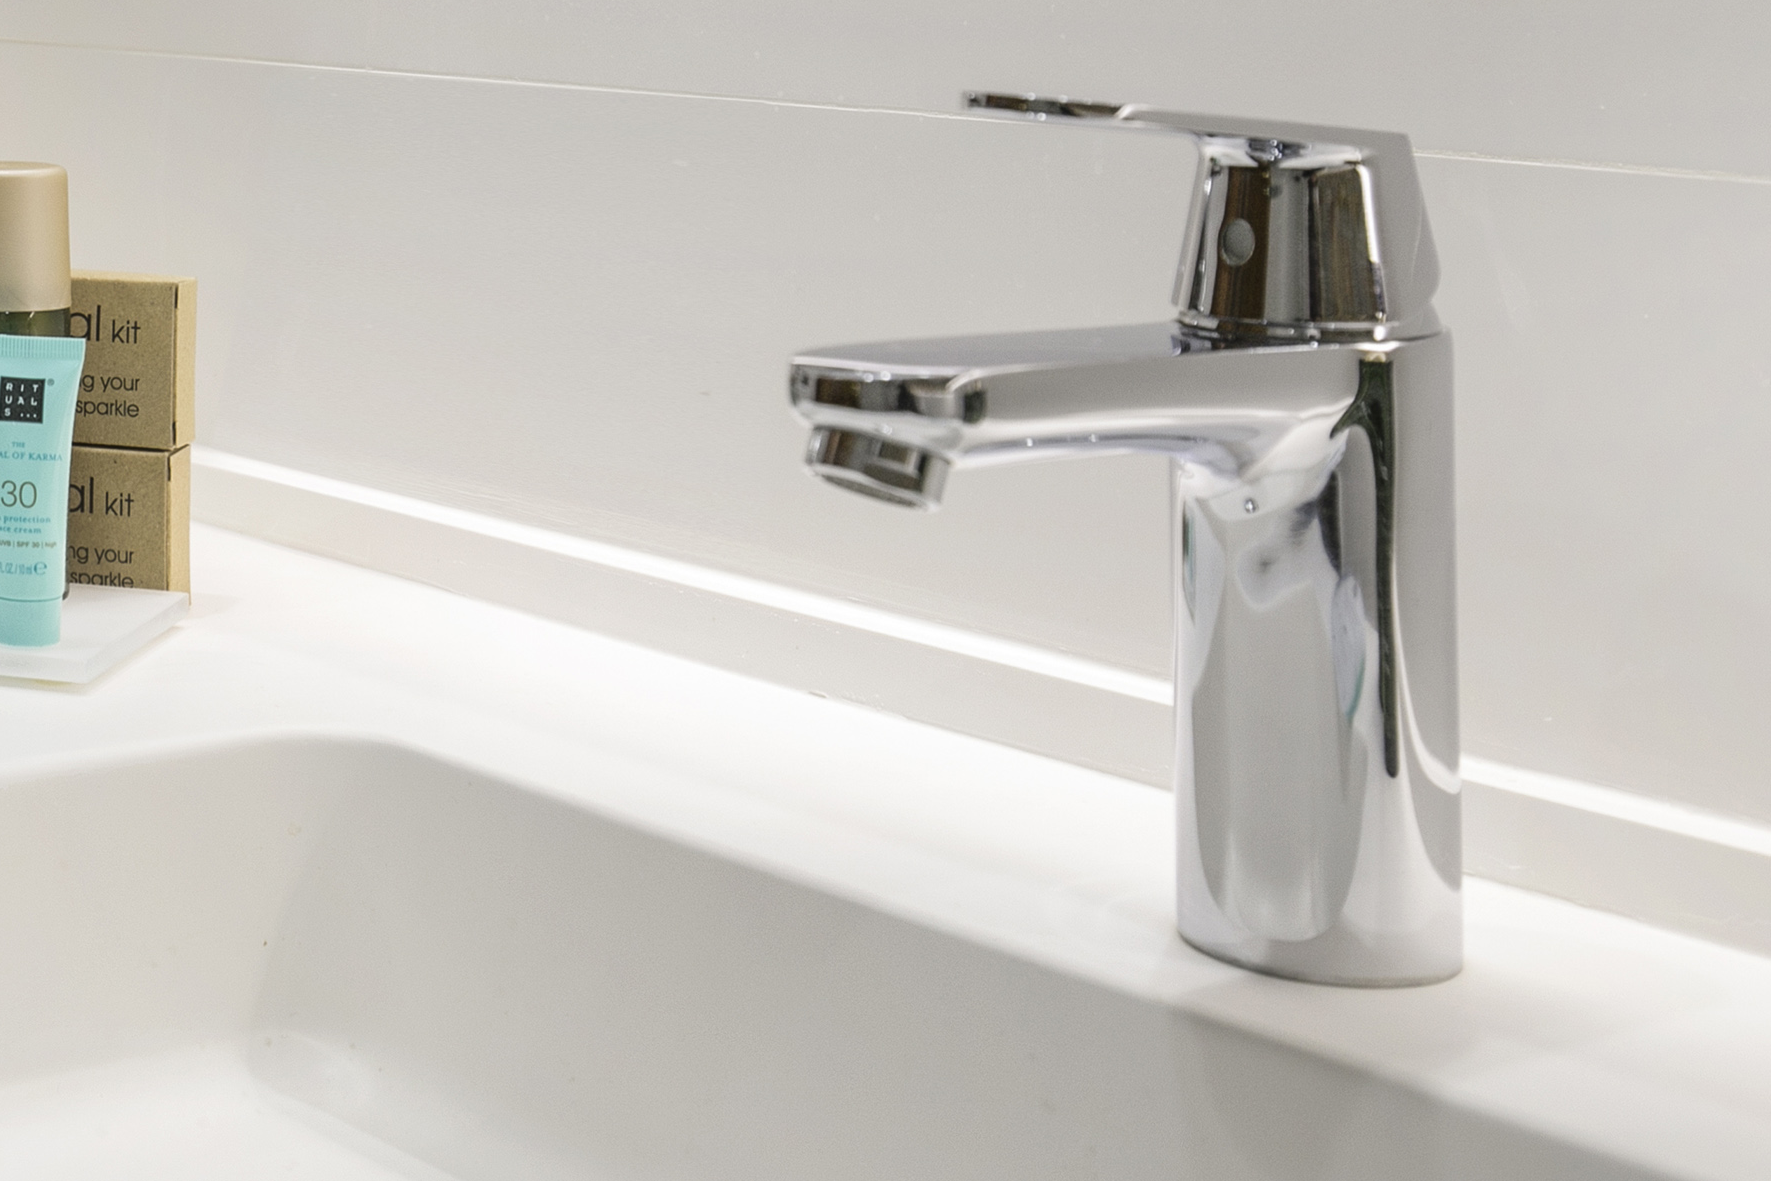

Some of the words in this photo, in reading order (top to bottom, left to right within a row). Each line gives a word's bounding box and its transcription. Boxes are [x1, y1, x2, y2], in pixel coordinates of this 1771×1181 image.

[112, 319, 141, 344] kit
[100, 376, 140, 393] your
[75, 399, 139, 418] sparkle
[12, 451, 25, 460] OF
[28, 452, 63, 461] KARMA
[1, 480, 37, 509] 30
[105, 491, 134, 517] kit
[3, 515, 51, 524] protection
[14, 526, 42, 534] cream
[94, 547, 134, 565] your
